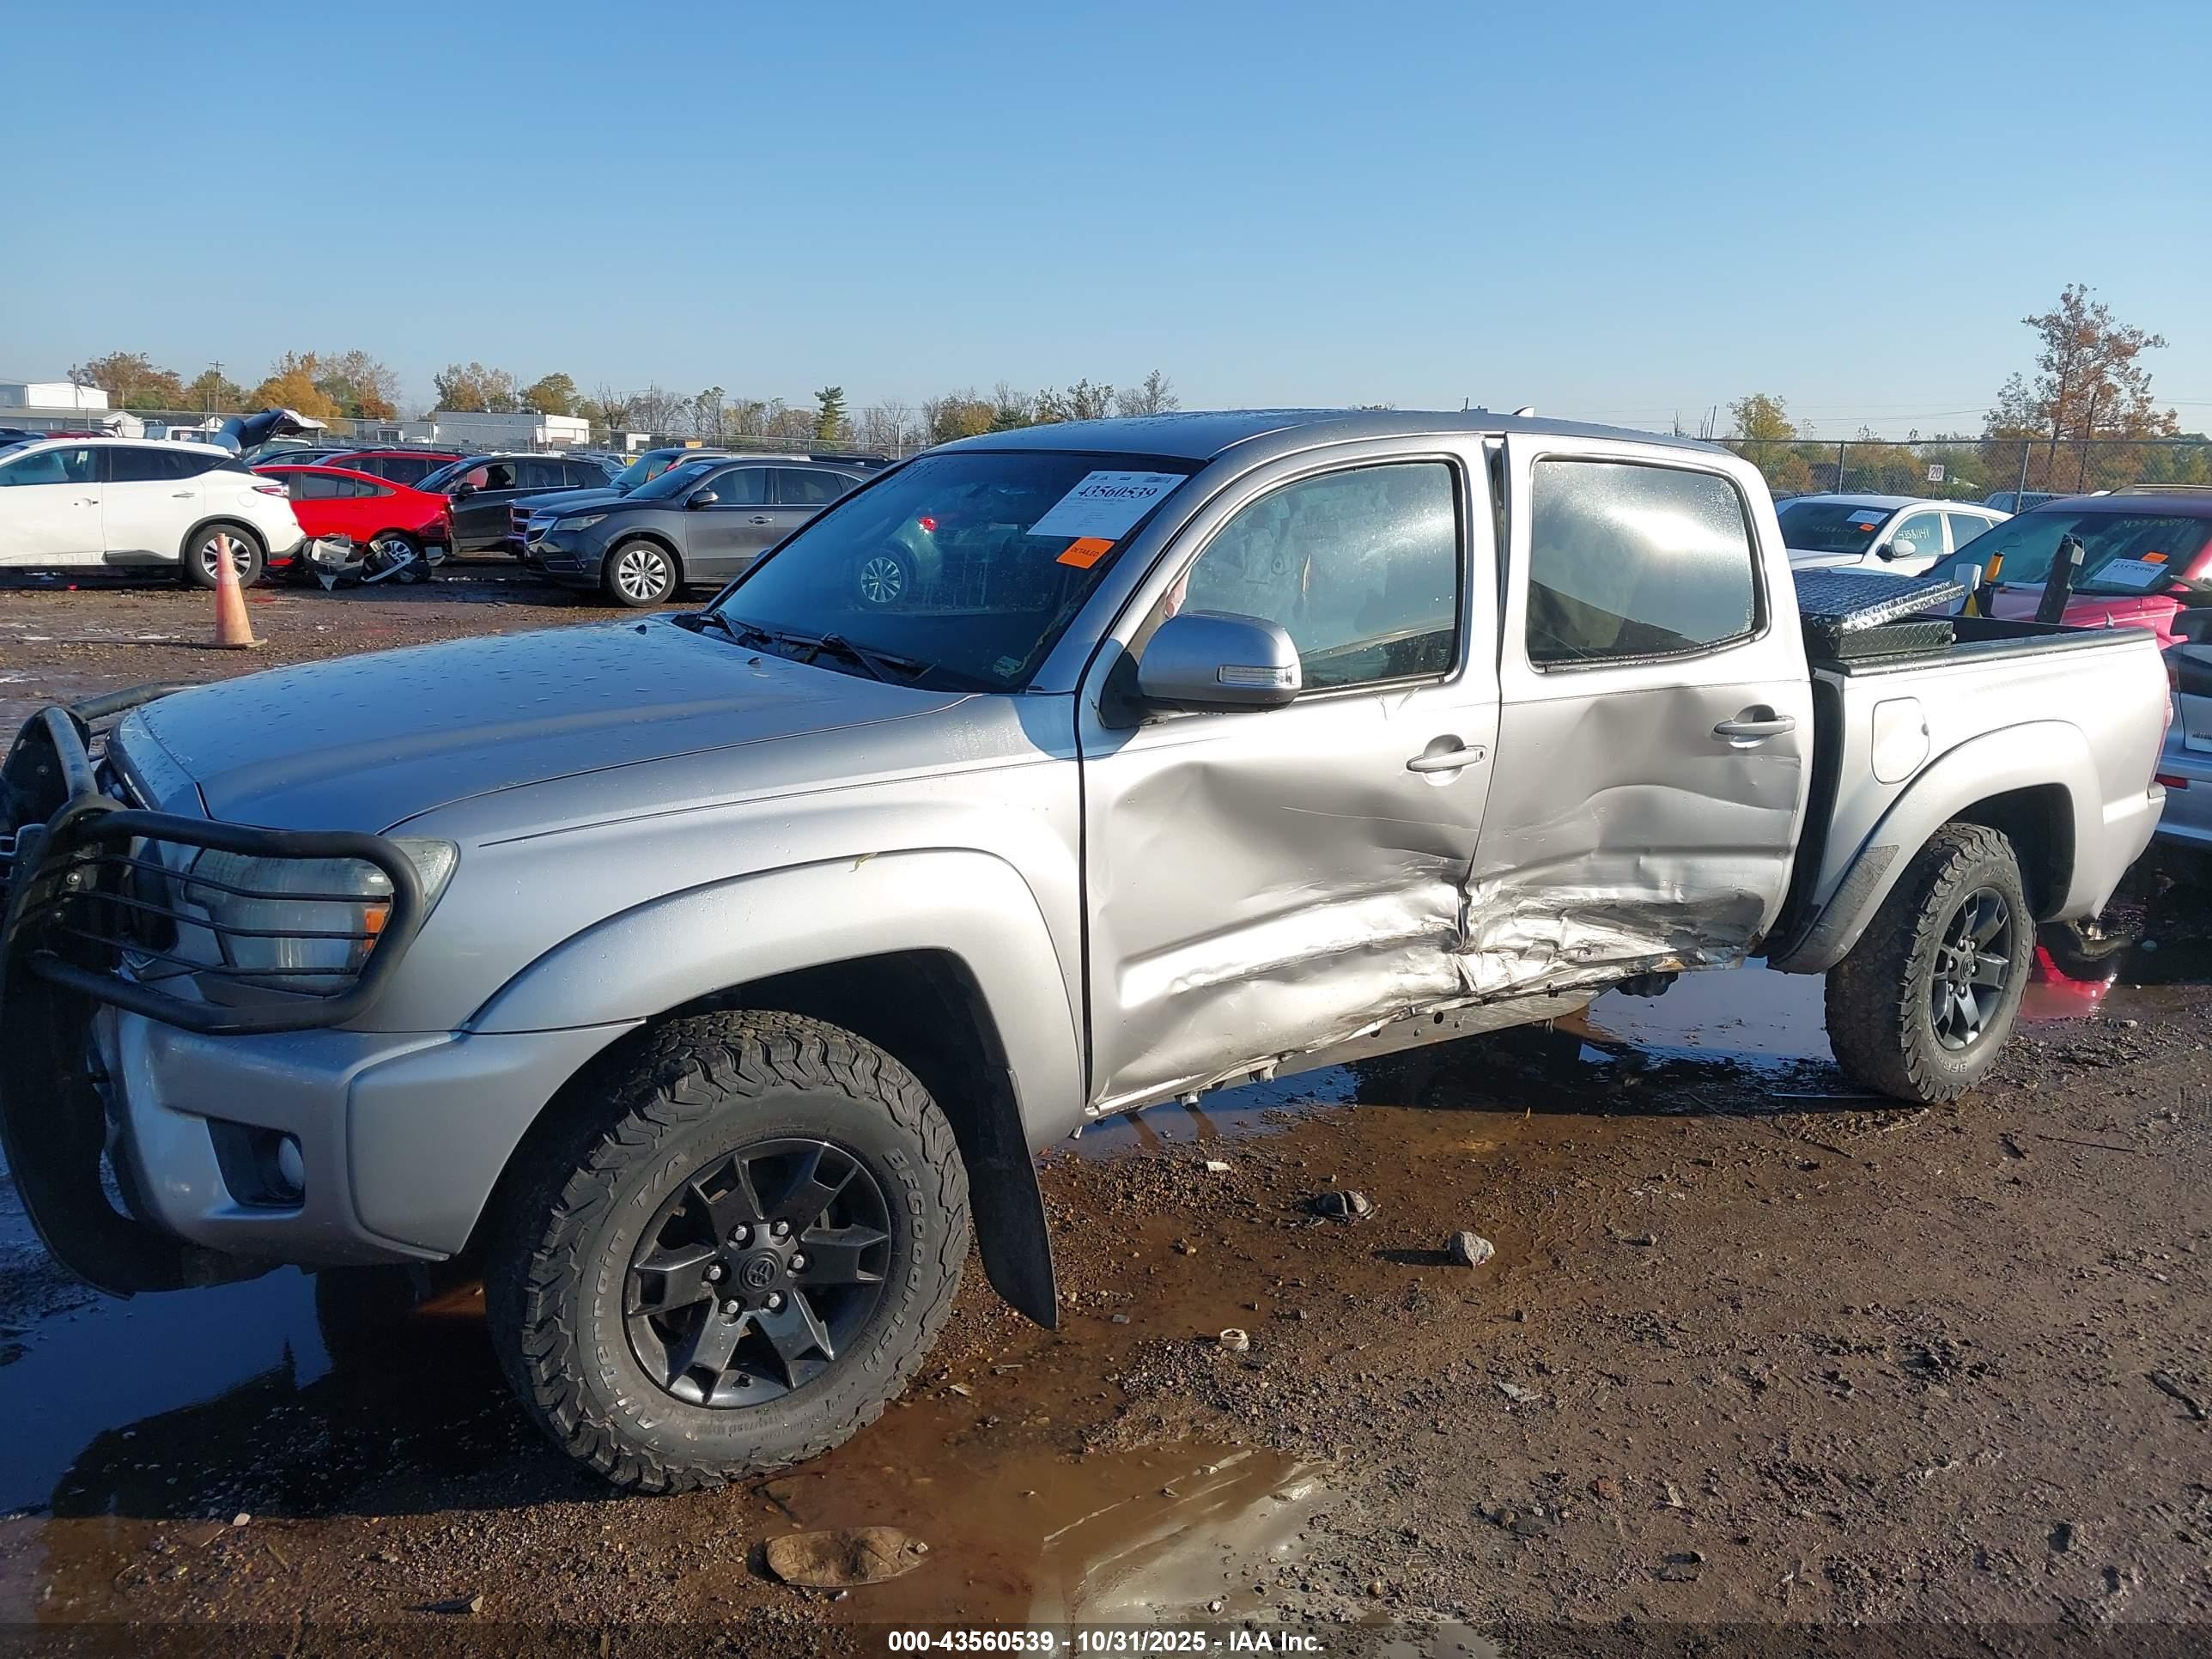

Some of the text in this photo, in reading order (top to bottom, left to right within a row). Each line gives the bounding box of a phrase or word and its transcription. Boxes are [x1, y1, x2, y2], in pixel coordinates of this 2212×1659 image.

[1930, 466, 1942, 480] 20
[1078, 484, 1158, 499] 43560539
[631, 1153, 686, 1208] T/A
[862, 1148, 926, 1372] BFGoodrich
